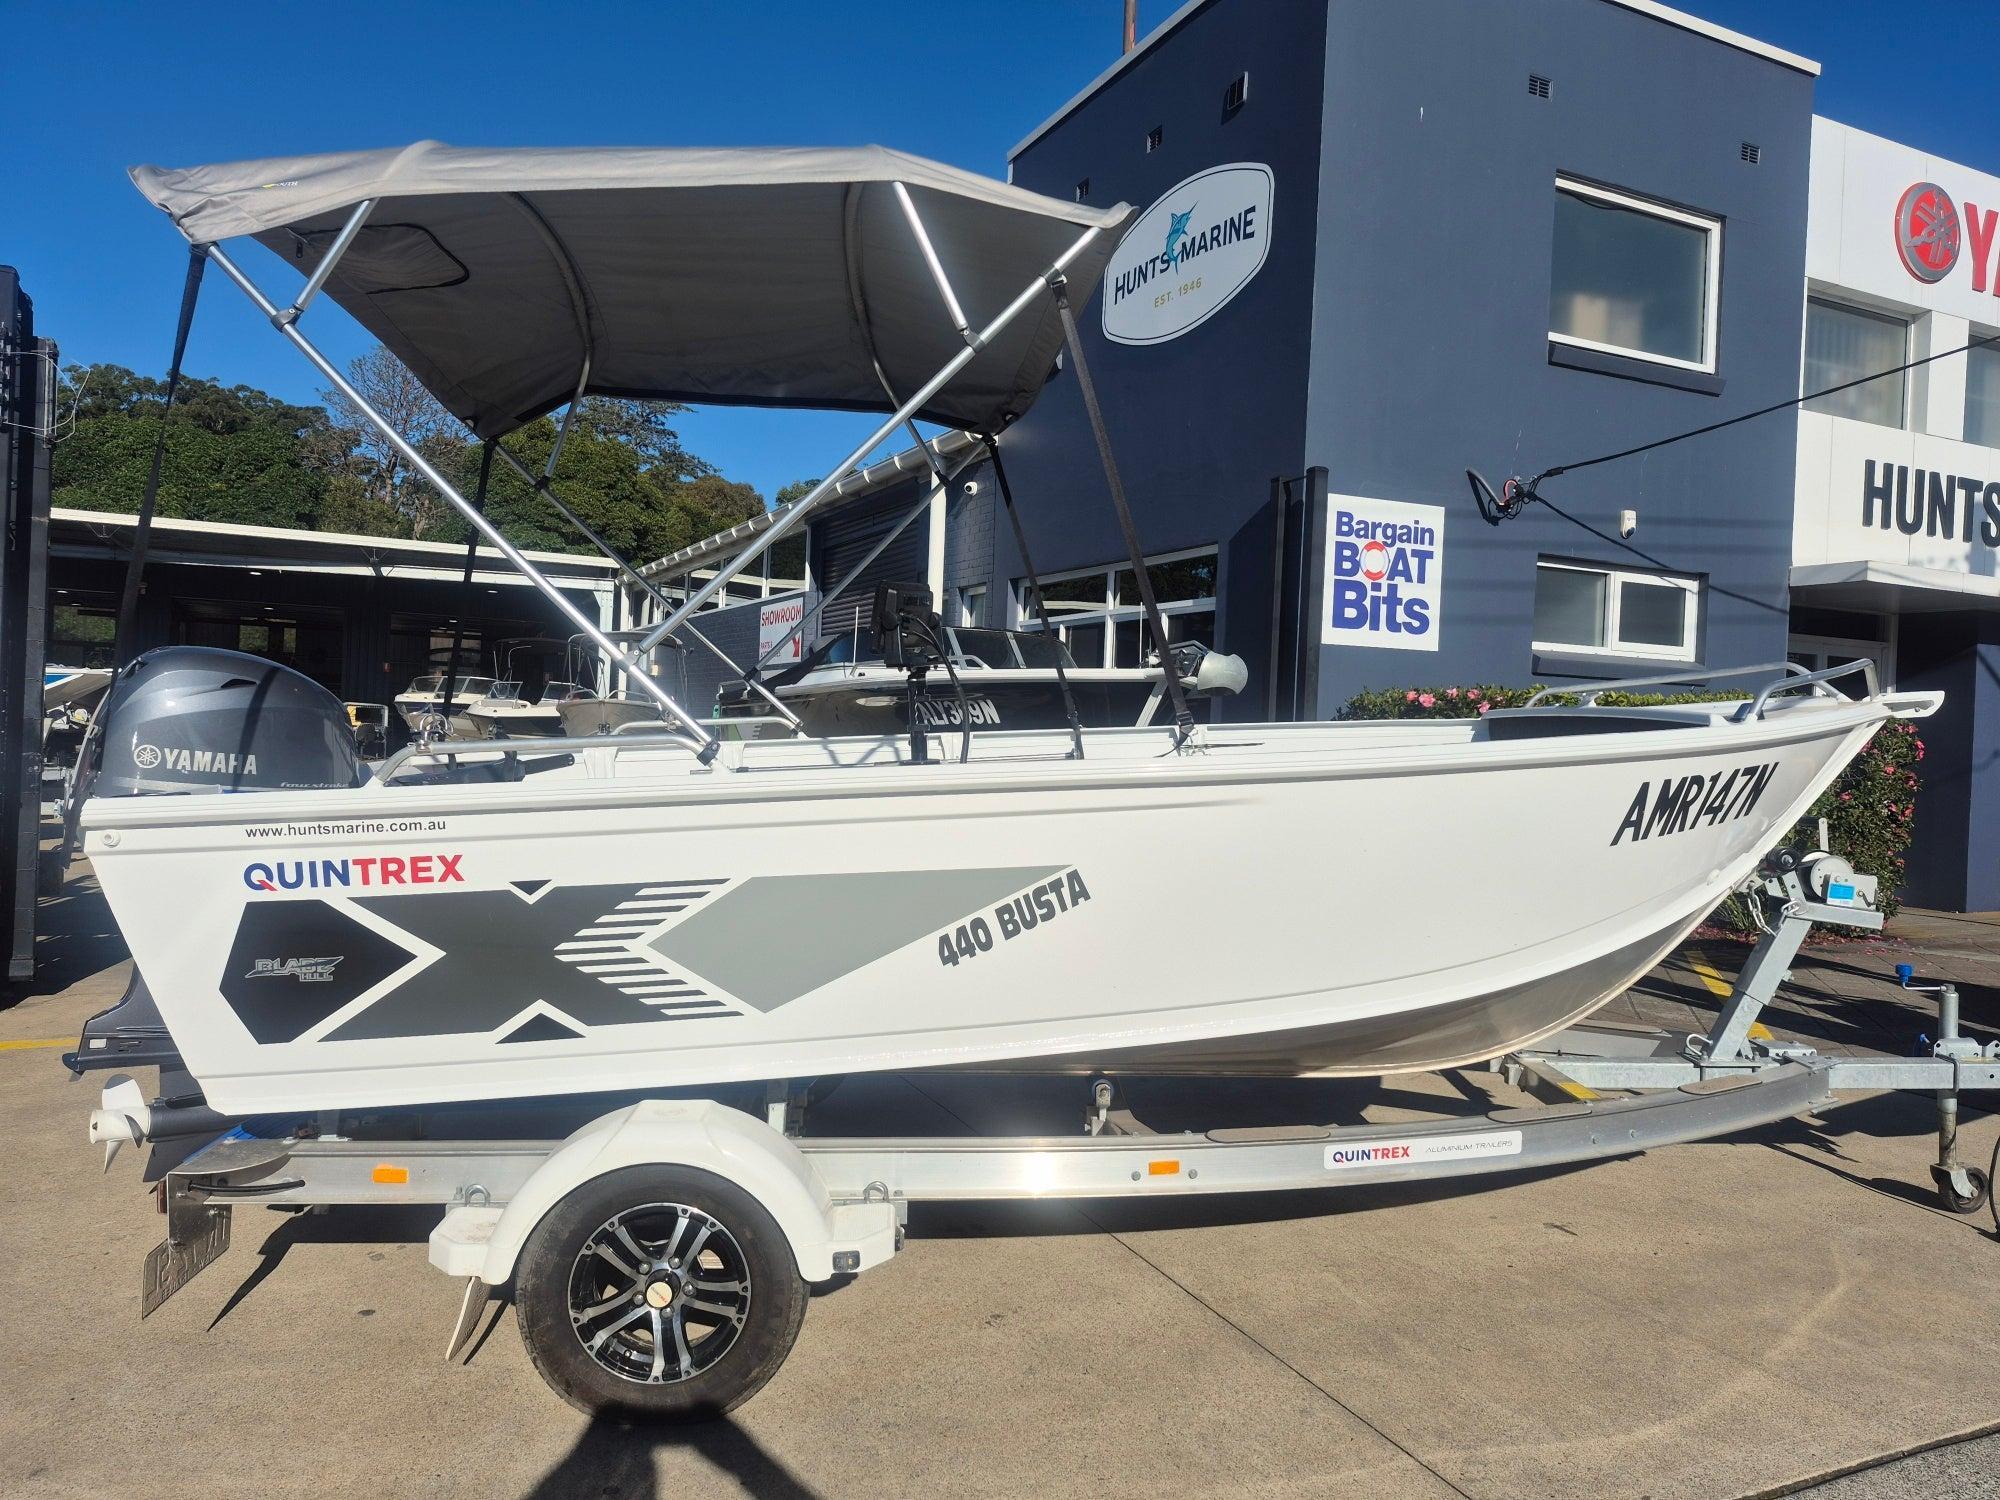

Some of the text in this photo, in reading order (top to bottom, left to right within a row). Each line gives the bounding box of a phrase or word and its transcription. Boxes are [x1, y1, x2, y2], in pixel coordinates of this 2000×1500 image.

[1114, 205, 1256, 305] HUNTS MARINE
[1963, 201, 2000, 298] Y
[1154, 276, 1202, 308] EST. 1946
[1862, 459, 2000, 548] HUNTS
[1335, 510, 1435, 547] Bargain
[1334, 540, 1434, 584] BOAT
[761, 604, 802, 627] SHOWROOM
[1332, 578, 1430, 635] Bits
[164, 748, 257, 775] YAMAHA
[1610, 761, 1780, 847] AMR147N
[245, 820, 447, 838] www.huntsmarine.com.au
[243, 854, 465, 892] QUINTREX
[937, 868, 1091, 967] 440 BUSTA
[1333, 1140, 1513, 1163] QUINTREX ALUMINIUM TRAILERS
